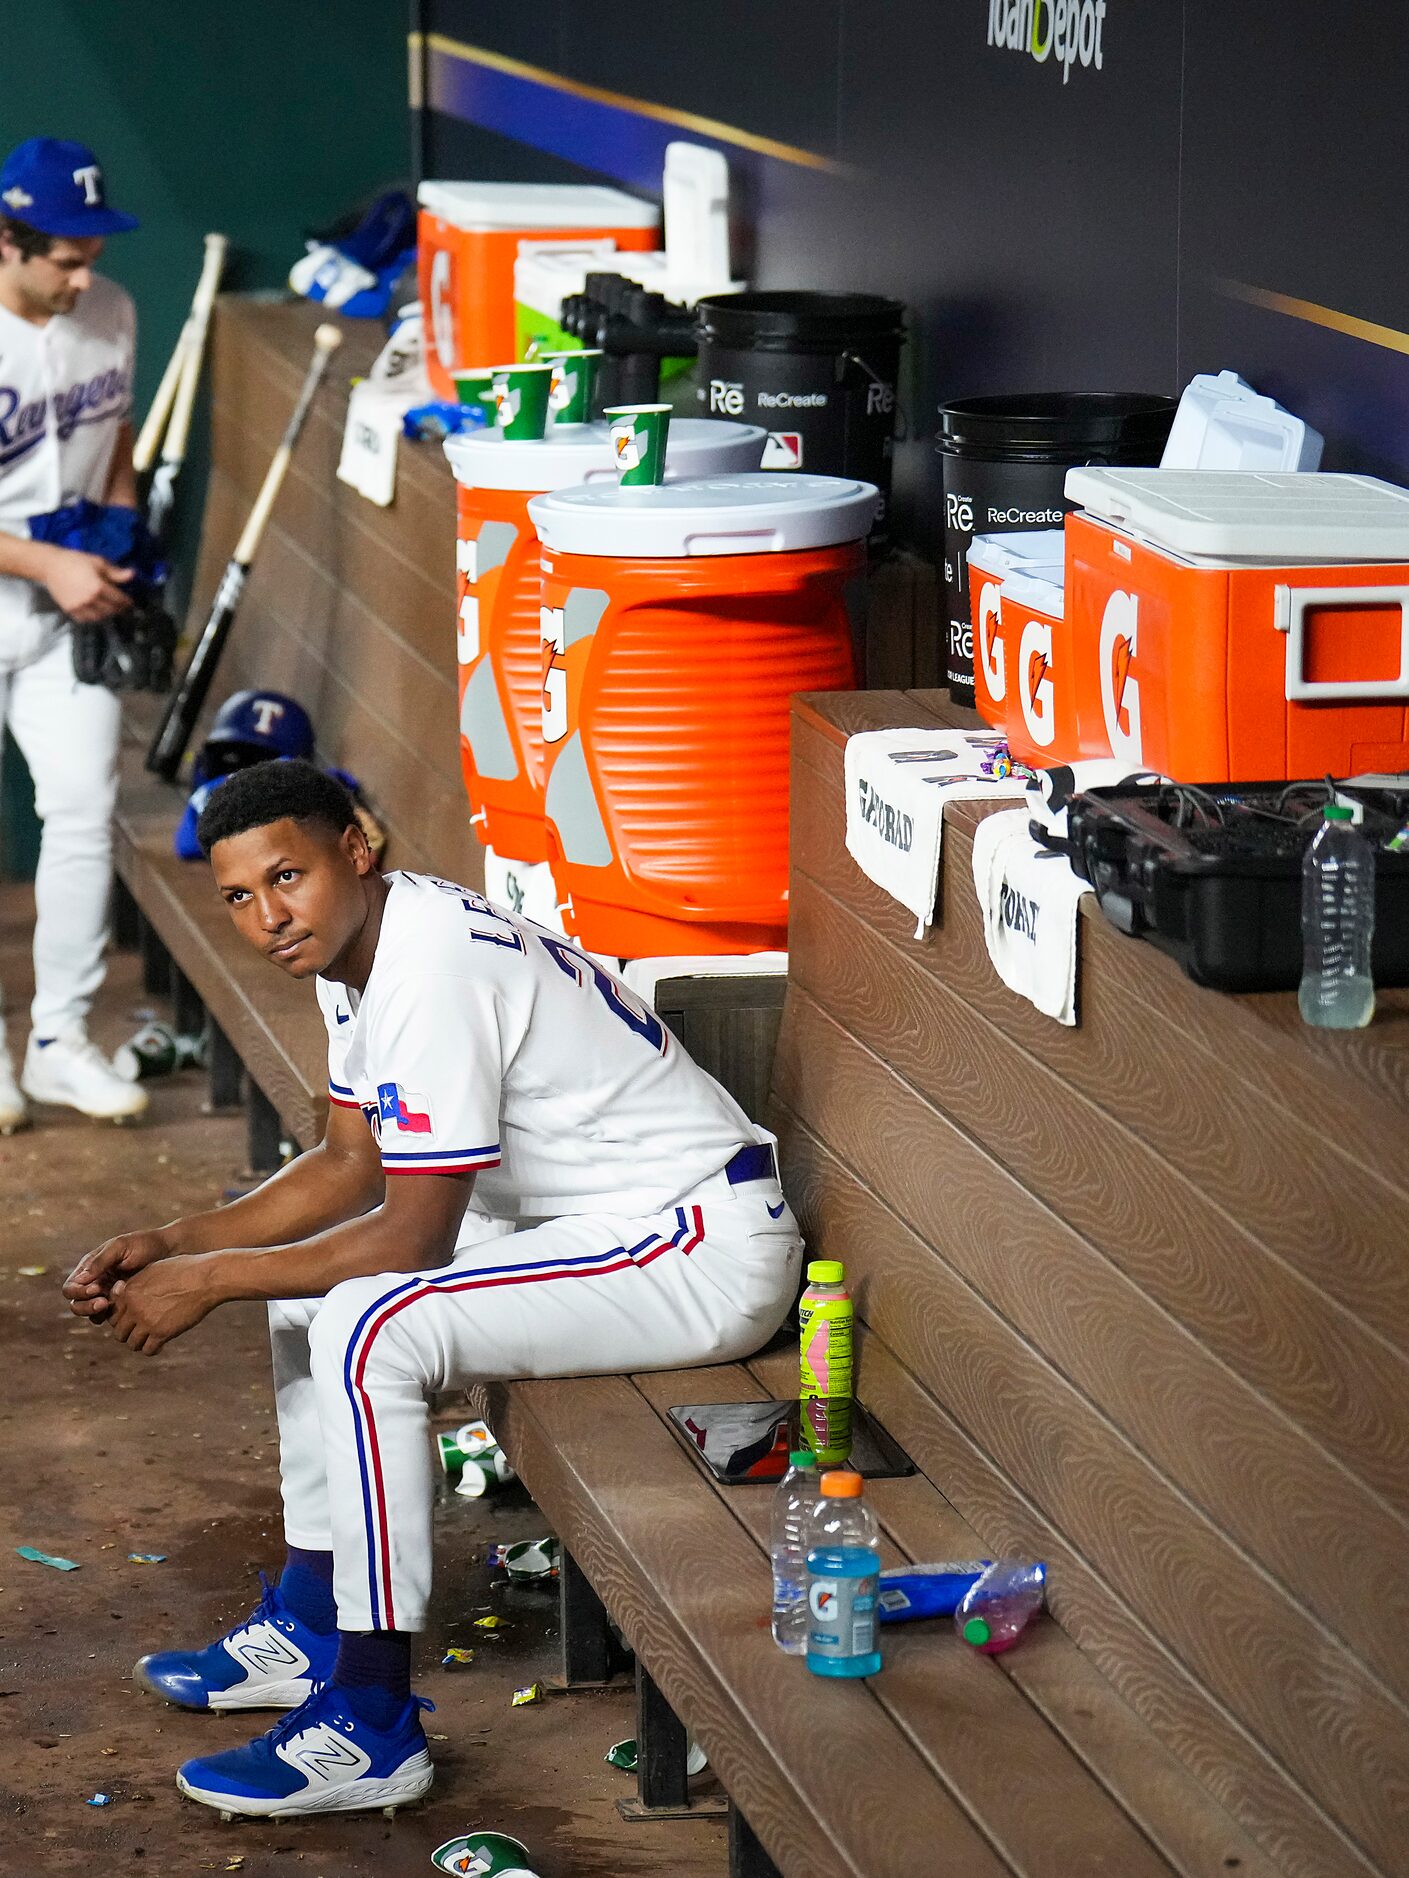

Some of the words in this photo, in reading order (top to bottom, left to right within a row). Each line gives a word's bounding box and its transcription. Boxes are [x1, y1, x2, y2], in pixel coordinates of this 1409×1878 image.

[72, 165, 101, 206] T
[757, 391, 829, 409] ReCreate
[987, 507, 1064, 524] ReCreate
[978, 581, 1007, 702] G
[953, 672, 974, 686] LEAGUE
[1018, 620, 1056, 747] G
[1099, 589, 1143, 764] G
[252, 699, 285, 735] T
[858, 778, 915, 853] GATORAD
[808, 1581, 839, 1622] G
